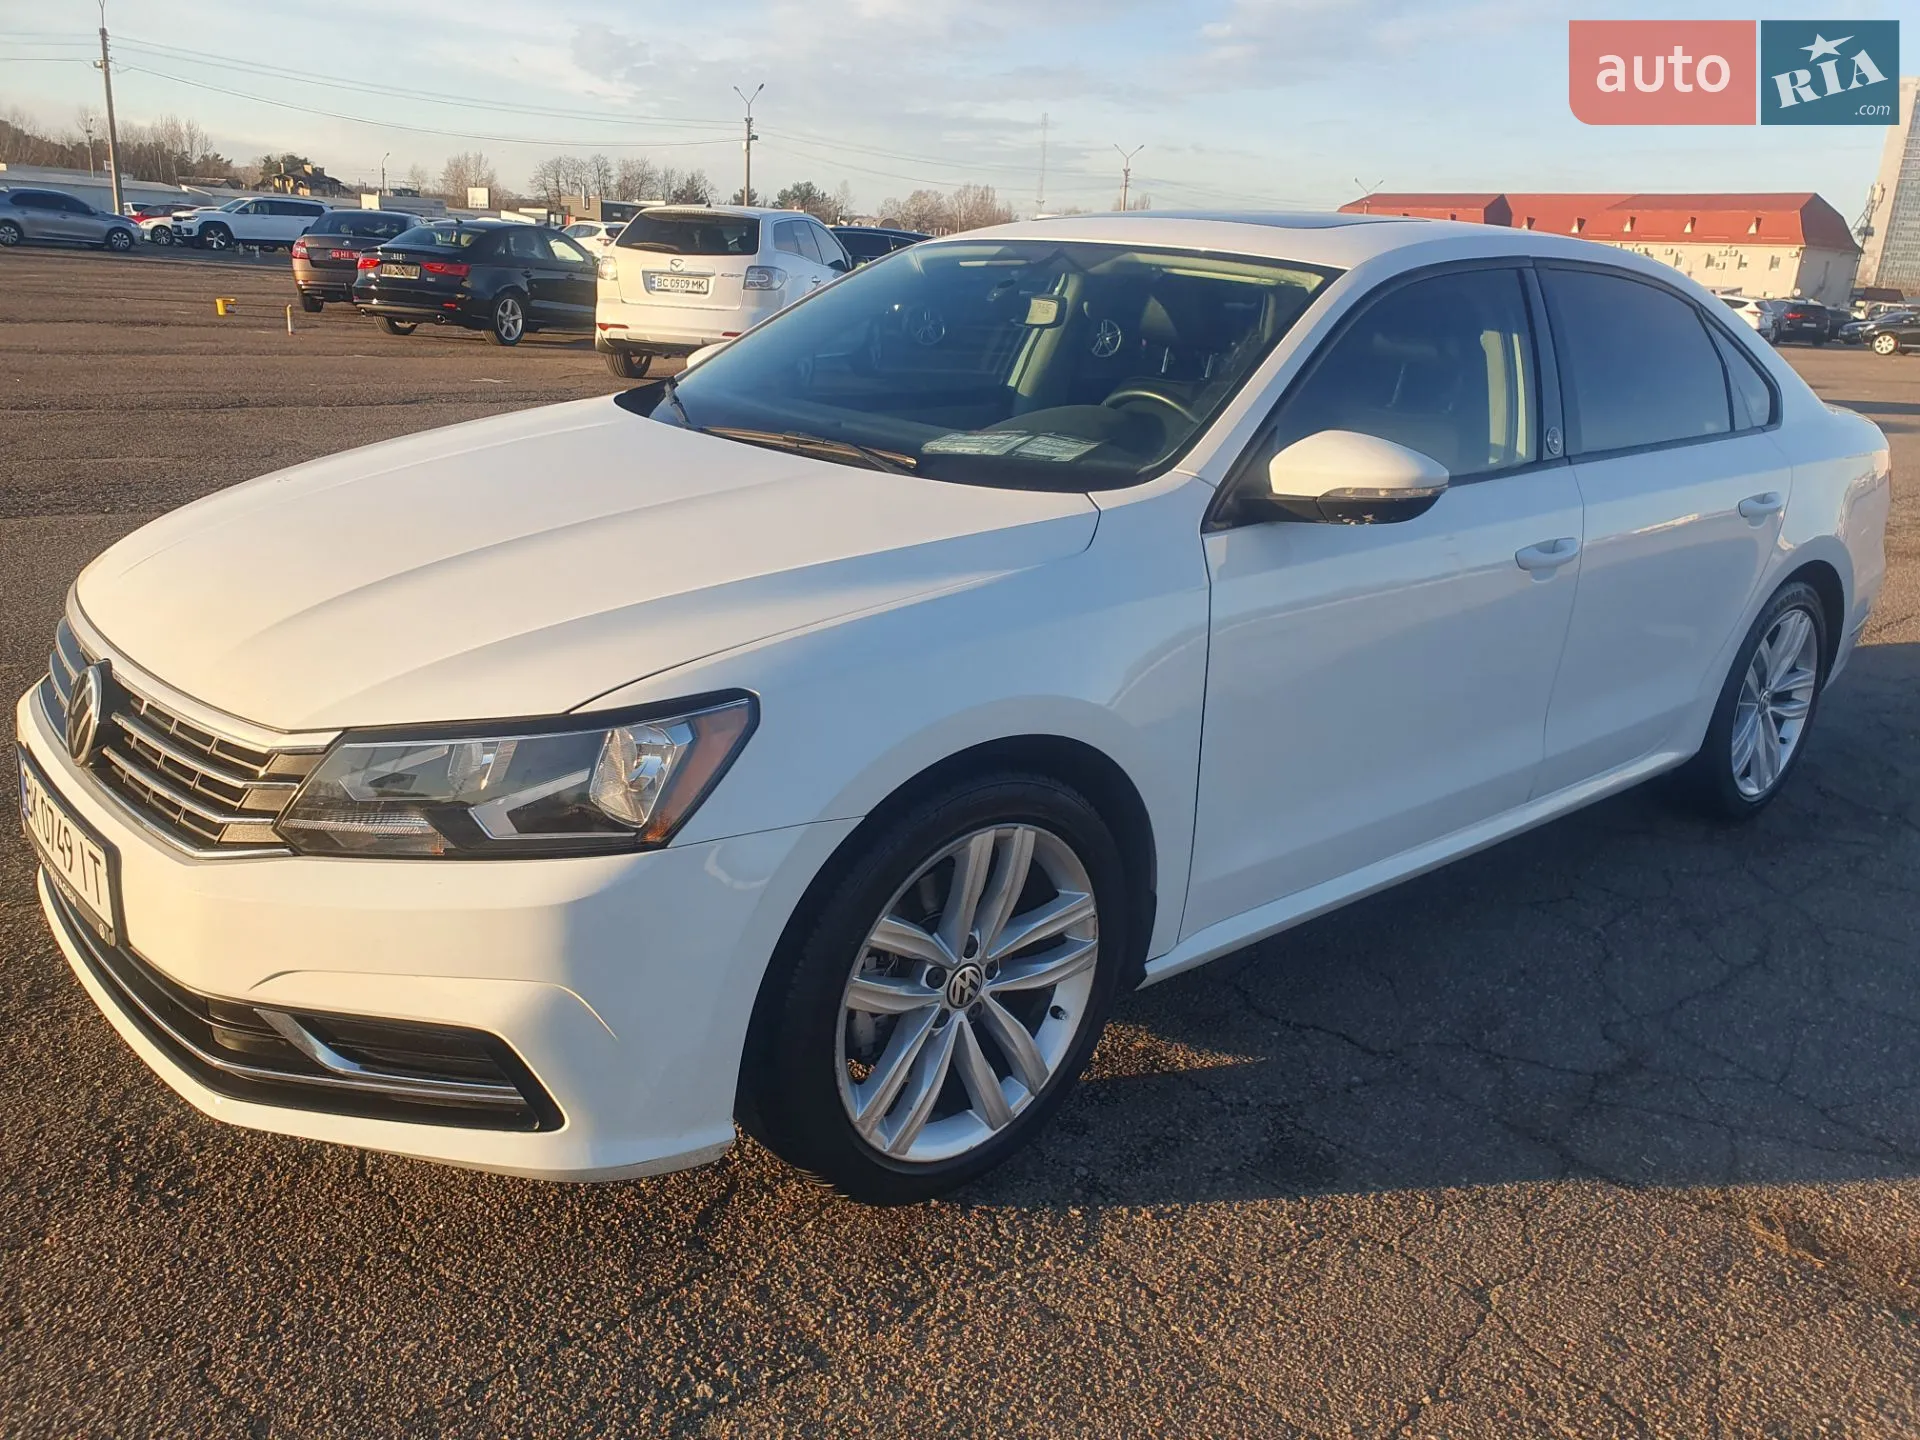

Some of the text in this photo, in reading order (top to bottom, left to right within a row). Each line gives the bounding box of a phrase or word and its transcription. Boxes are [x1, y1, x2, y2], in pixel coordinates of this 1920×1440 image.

[656, 278, 705, 290] BC 0909 MK
[41, 796, 73, 873] 0749
[80, 840, 101, 906] IT
